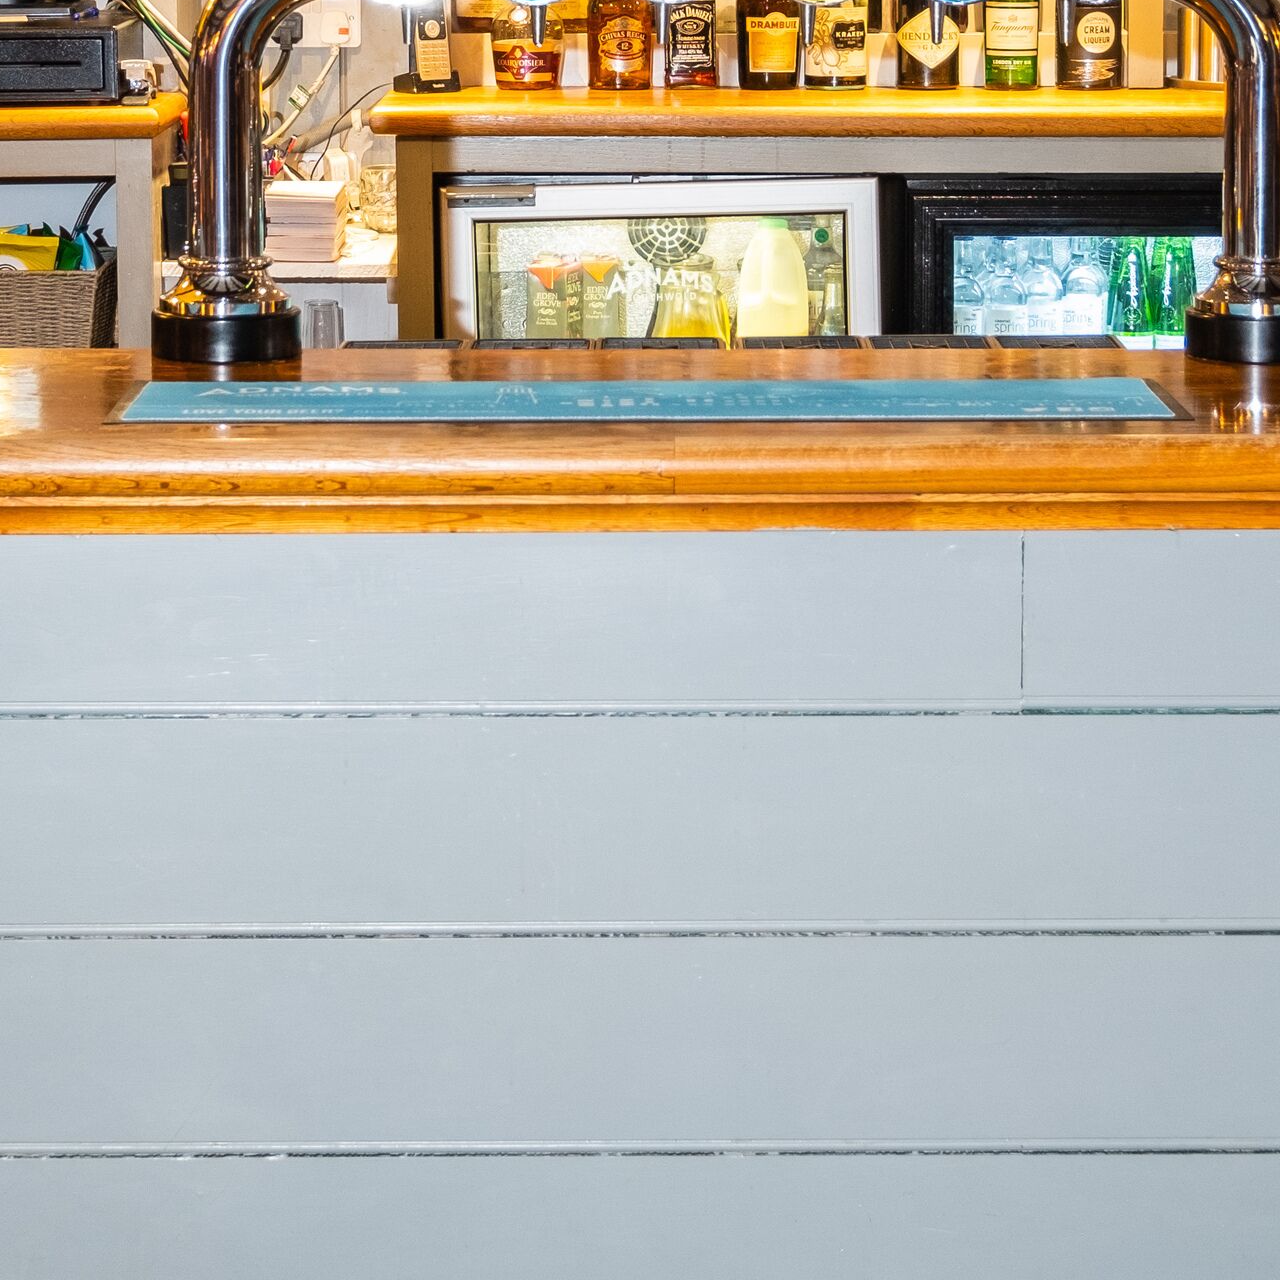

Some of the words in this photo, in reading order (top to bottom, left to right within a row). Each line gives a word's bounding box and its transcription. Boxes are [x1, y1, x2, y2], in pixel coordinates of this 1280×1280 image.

[750, 21, 797, 29] DRAMBUIE
[990, 22, 1034, 33] Tanqueray
[1084, 26, 1110, 34] CREAM
[601, 31, 625, 42] CHIVAS
[626, 31, 646, 40] REGAL
[1084, 36, 1110, 45] LIQUEUR
